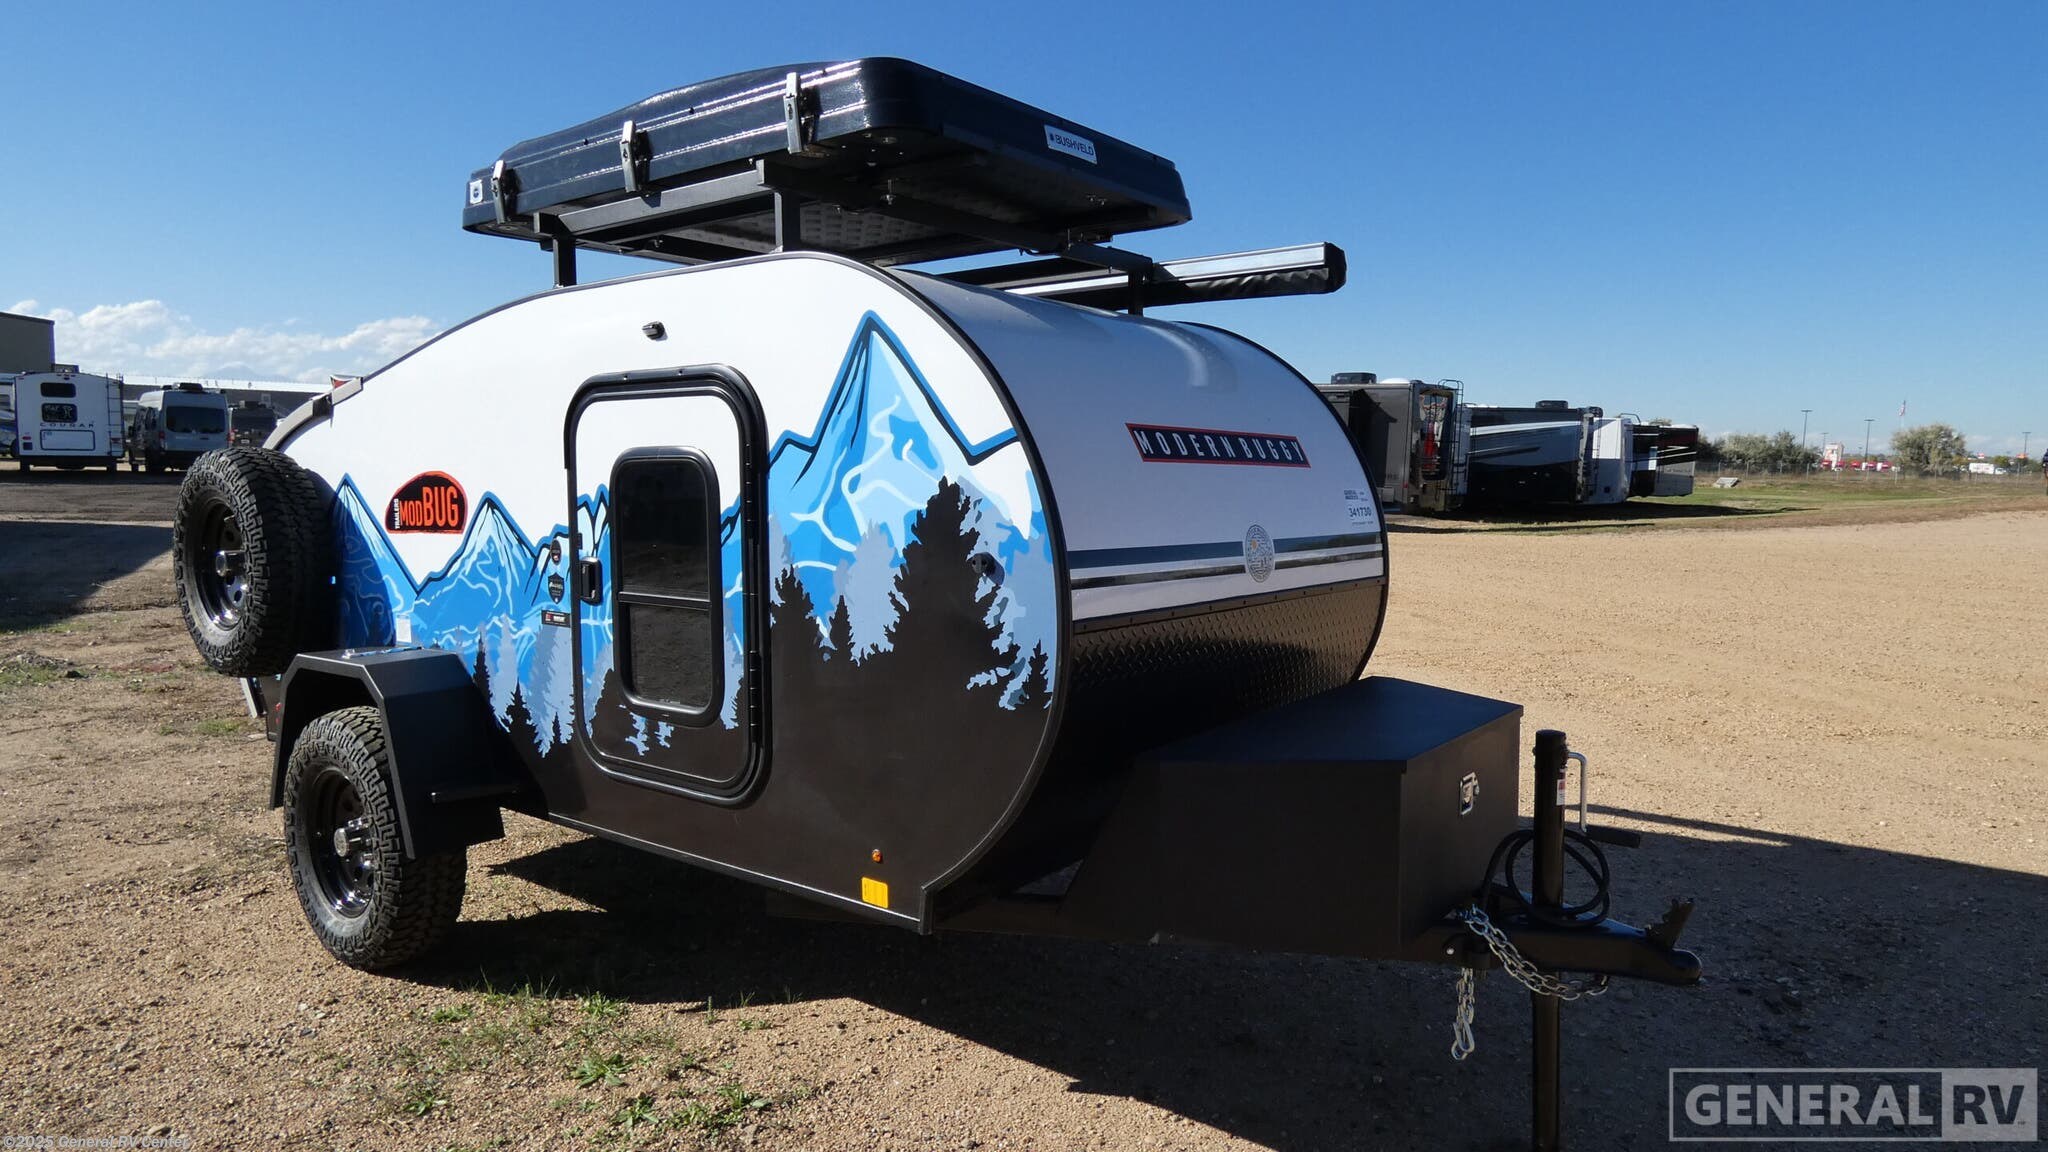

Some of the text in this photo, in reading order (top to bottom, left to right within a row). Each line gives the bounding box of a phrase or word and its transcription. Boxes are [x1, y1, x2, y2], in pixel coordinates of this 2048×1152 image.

[1055, 135, 1094, 156] BUSHVELD
[1133, 430, 1304, 461] MODERN BUGGY
